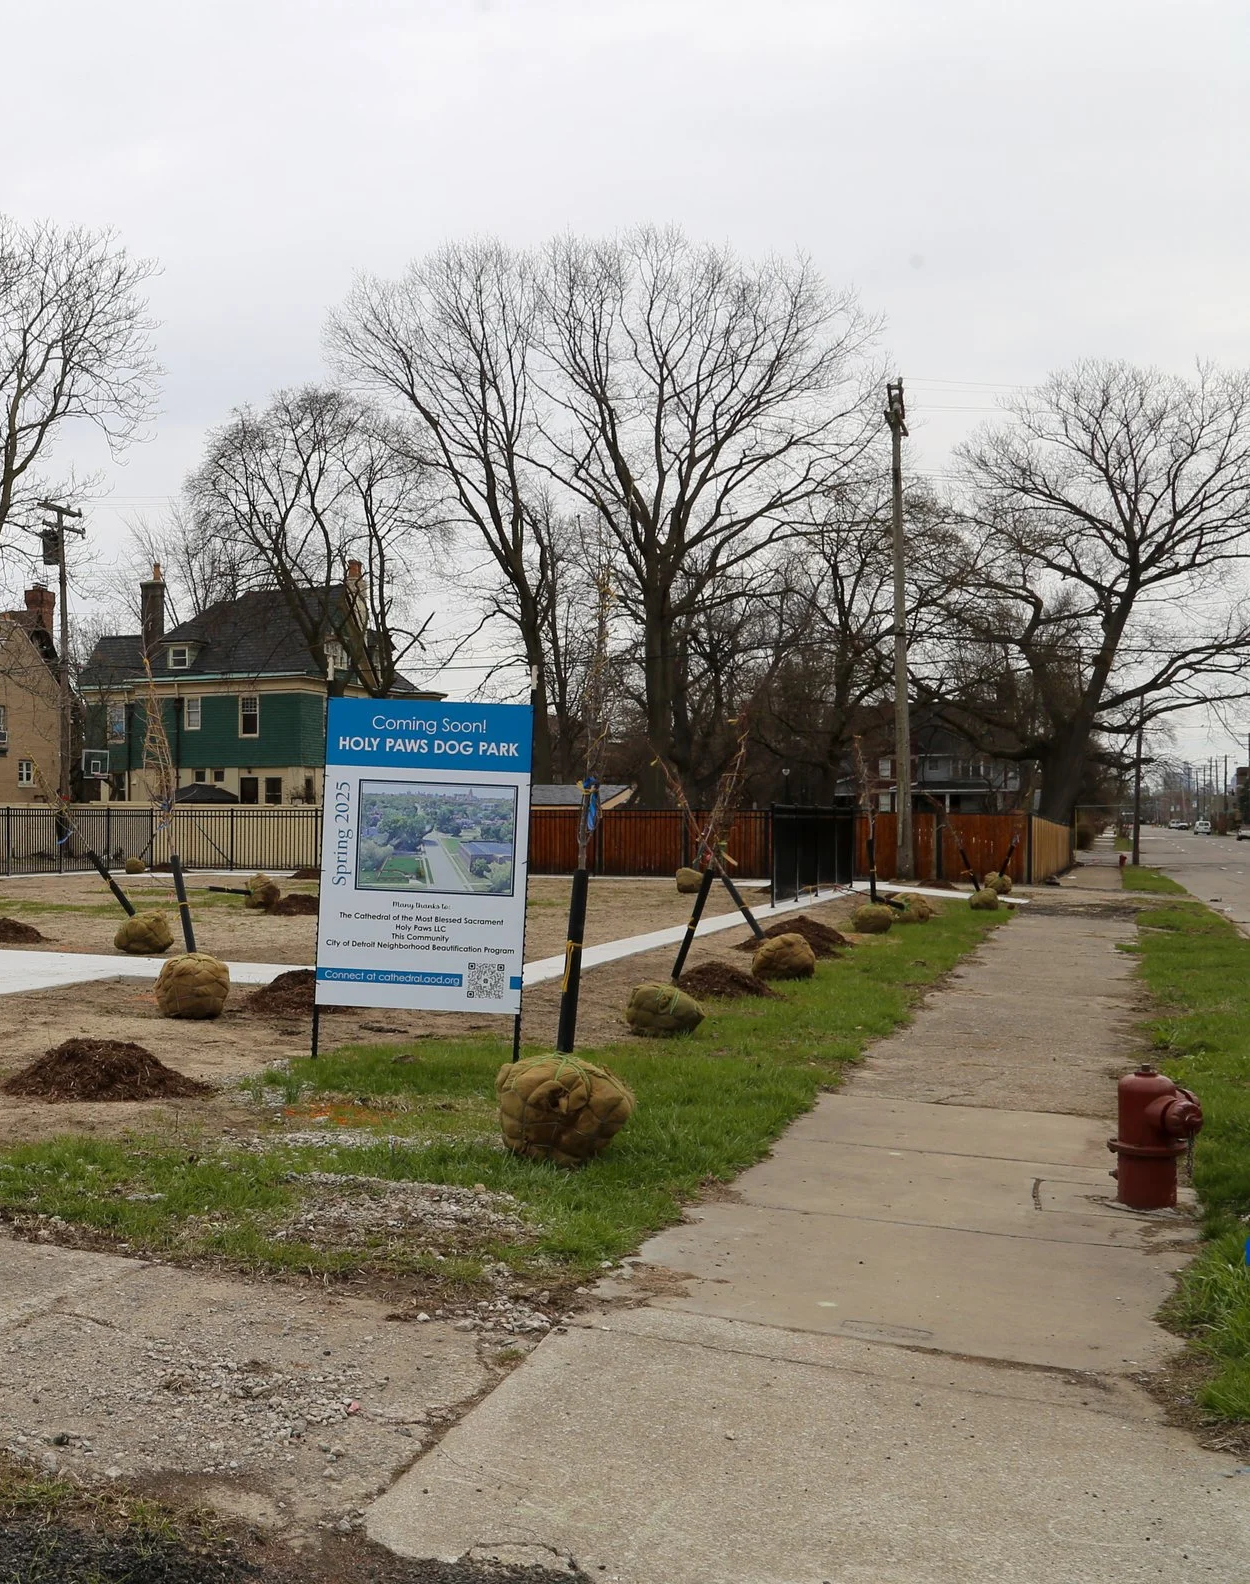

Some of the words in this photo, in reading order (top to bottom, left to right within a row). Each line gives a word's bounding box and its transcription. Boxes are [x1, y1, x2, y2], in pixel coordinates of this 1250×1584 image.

[372, 715, 437, 734] Coming
[441, 717, 487, 734] Soon!
[338, 736, 381, 752] HOLY
[385, 738, 429, 754] PAWS
[434, 740, 473, 755] DOG
[478, 742, 519, 757] PARK
[335, 781, 351, 823] 2025
[331, 828, 353, 886] Spring
[392, 901, 414, 910] Many
[415, 902, 440, 910] thanks
[339, 911, 352, 919] The
[354, 912, 391, 921] Cathedral
[401, 914, 413, 922] the
[415, 915, 433, 923] Most
[434, 916, 462, 924] Blessed
[464, 917, 504, 926] Sacrament
[395, 924, 412, 932] Holy
[434, 925, 447, 933] LLC
[406, 933, 450, 943] Community
[326, 939, 341, 947] City
[351, 940, 375, 948] Detroit
[377, 941, 430, 951] Neighborhood
[432, 944, 482, 953] Beautification
[483, 946, 515, 955] Program
[324, 969, 364, 980] Connect
[366, 972, 376, 981] at
[378, 973, 460, 986] cathedral.aod.org
